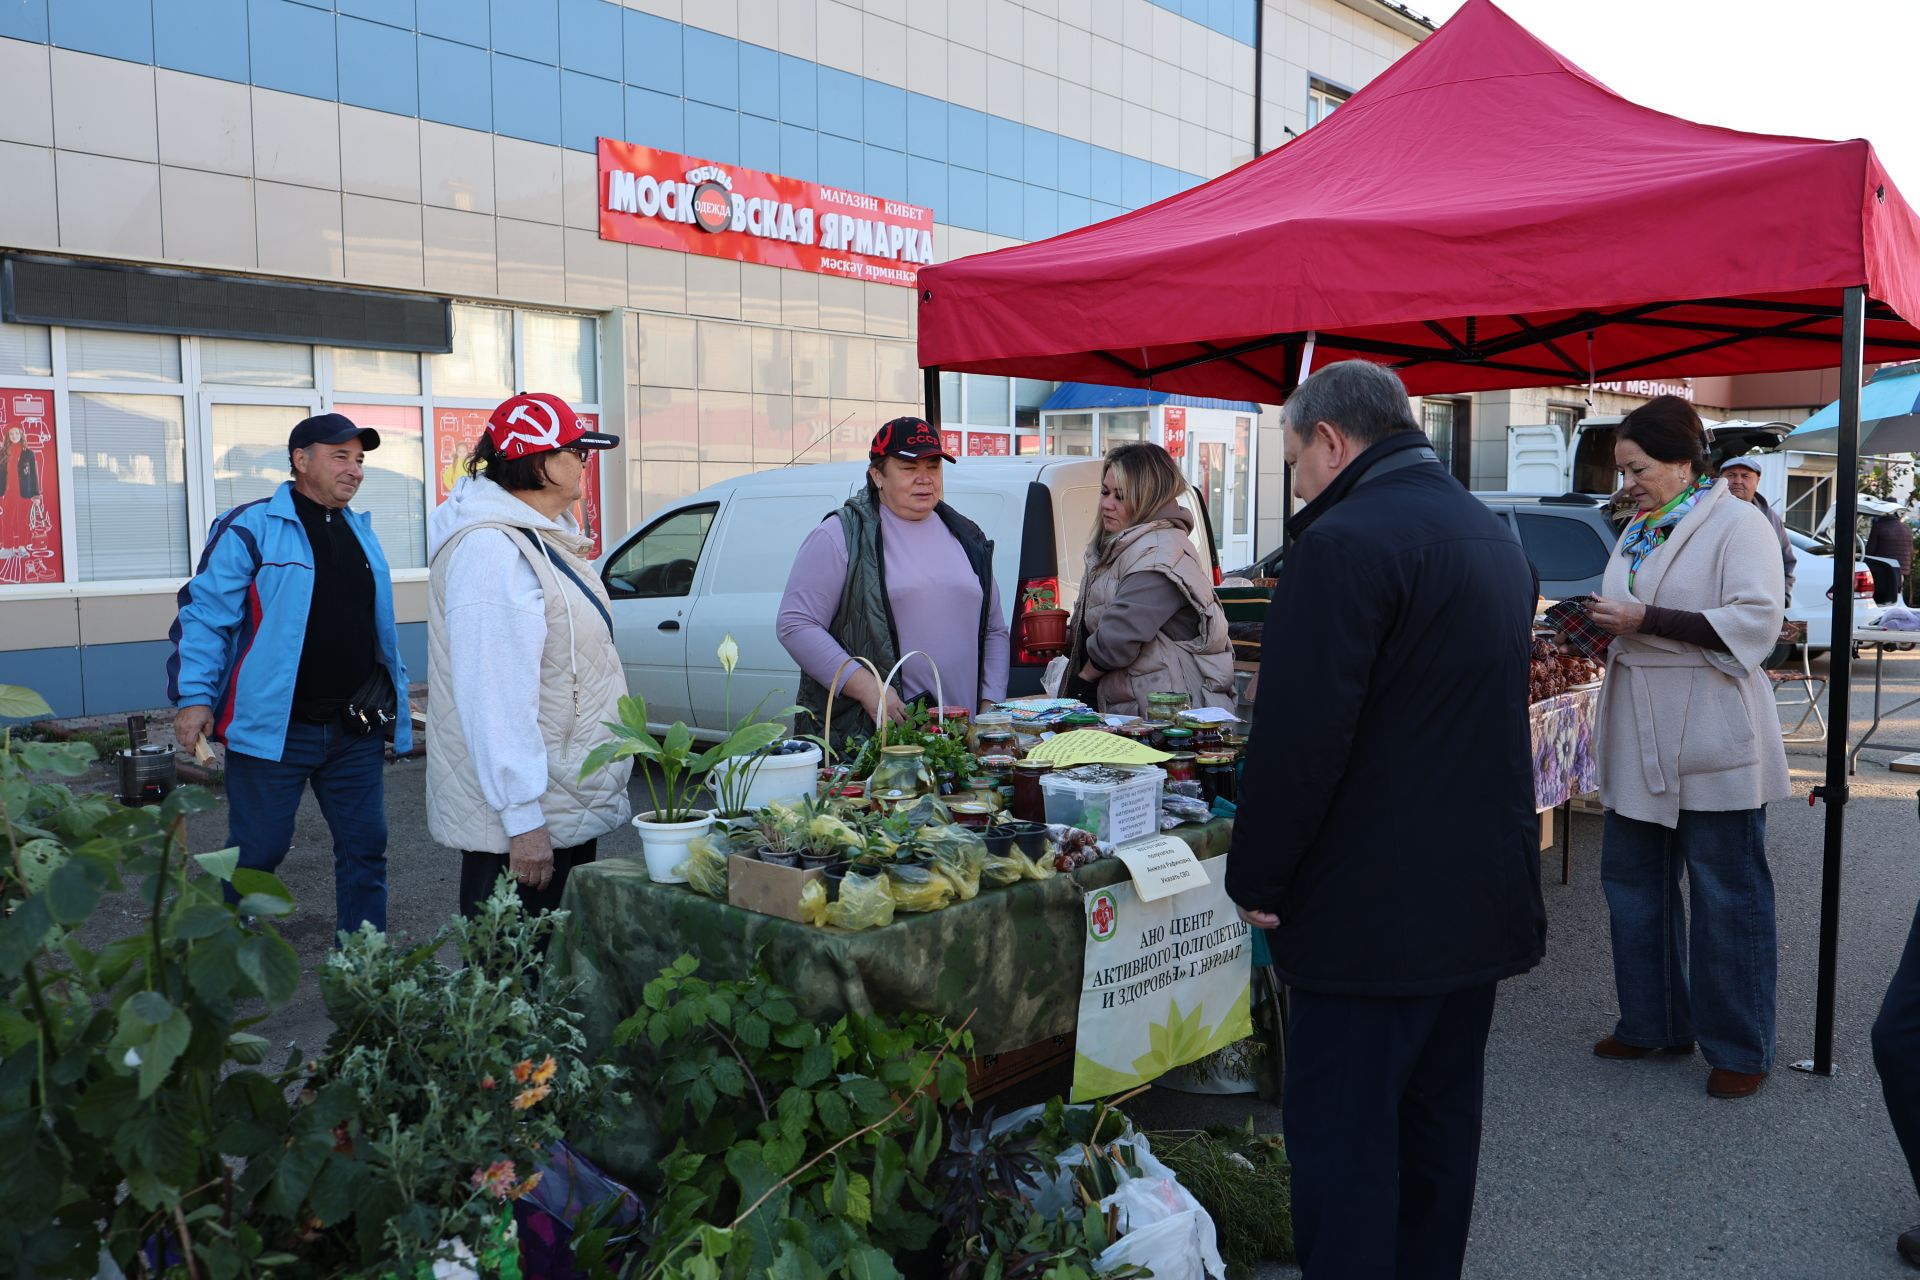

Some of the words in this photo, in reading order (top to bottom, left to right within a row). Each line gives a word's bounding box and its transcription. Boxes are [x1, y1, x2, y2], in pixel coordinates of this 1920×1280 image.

[685, 166, 733, 191] ОБУВЬ
[694, 200, 732, 218] ОДЕЖДА
[820, 188, 878, 211] МАГАЗИН
[884, 200, 924, 221] КИБЕТ
[819, 212, 935, 265] ЯРМАРКА
[821, 257, 863, 276] мәскәү
[866, 264, 917, 282] ярминкә
[1626, 379, 1694, 402] мелочей
[1167, 429, 1184, 442] 8-19
[1160, 873, 1181, 884] Указать
[1180, 869, 1191, 879] СВО
[1140, 925, 1165, 949] АНО
[1092, 947, 1170, 988] АКТИВНОГО
[1171, 920, 1248, 961] ДОЛГОЛЕТИЯ
[1102, 991, 1115, 1009] И
